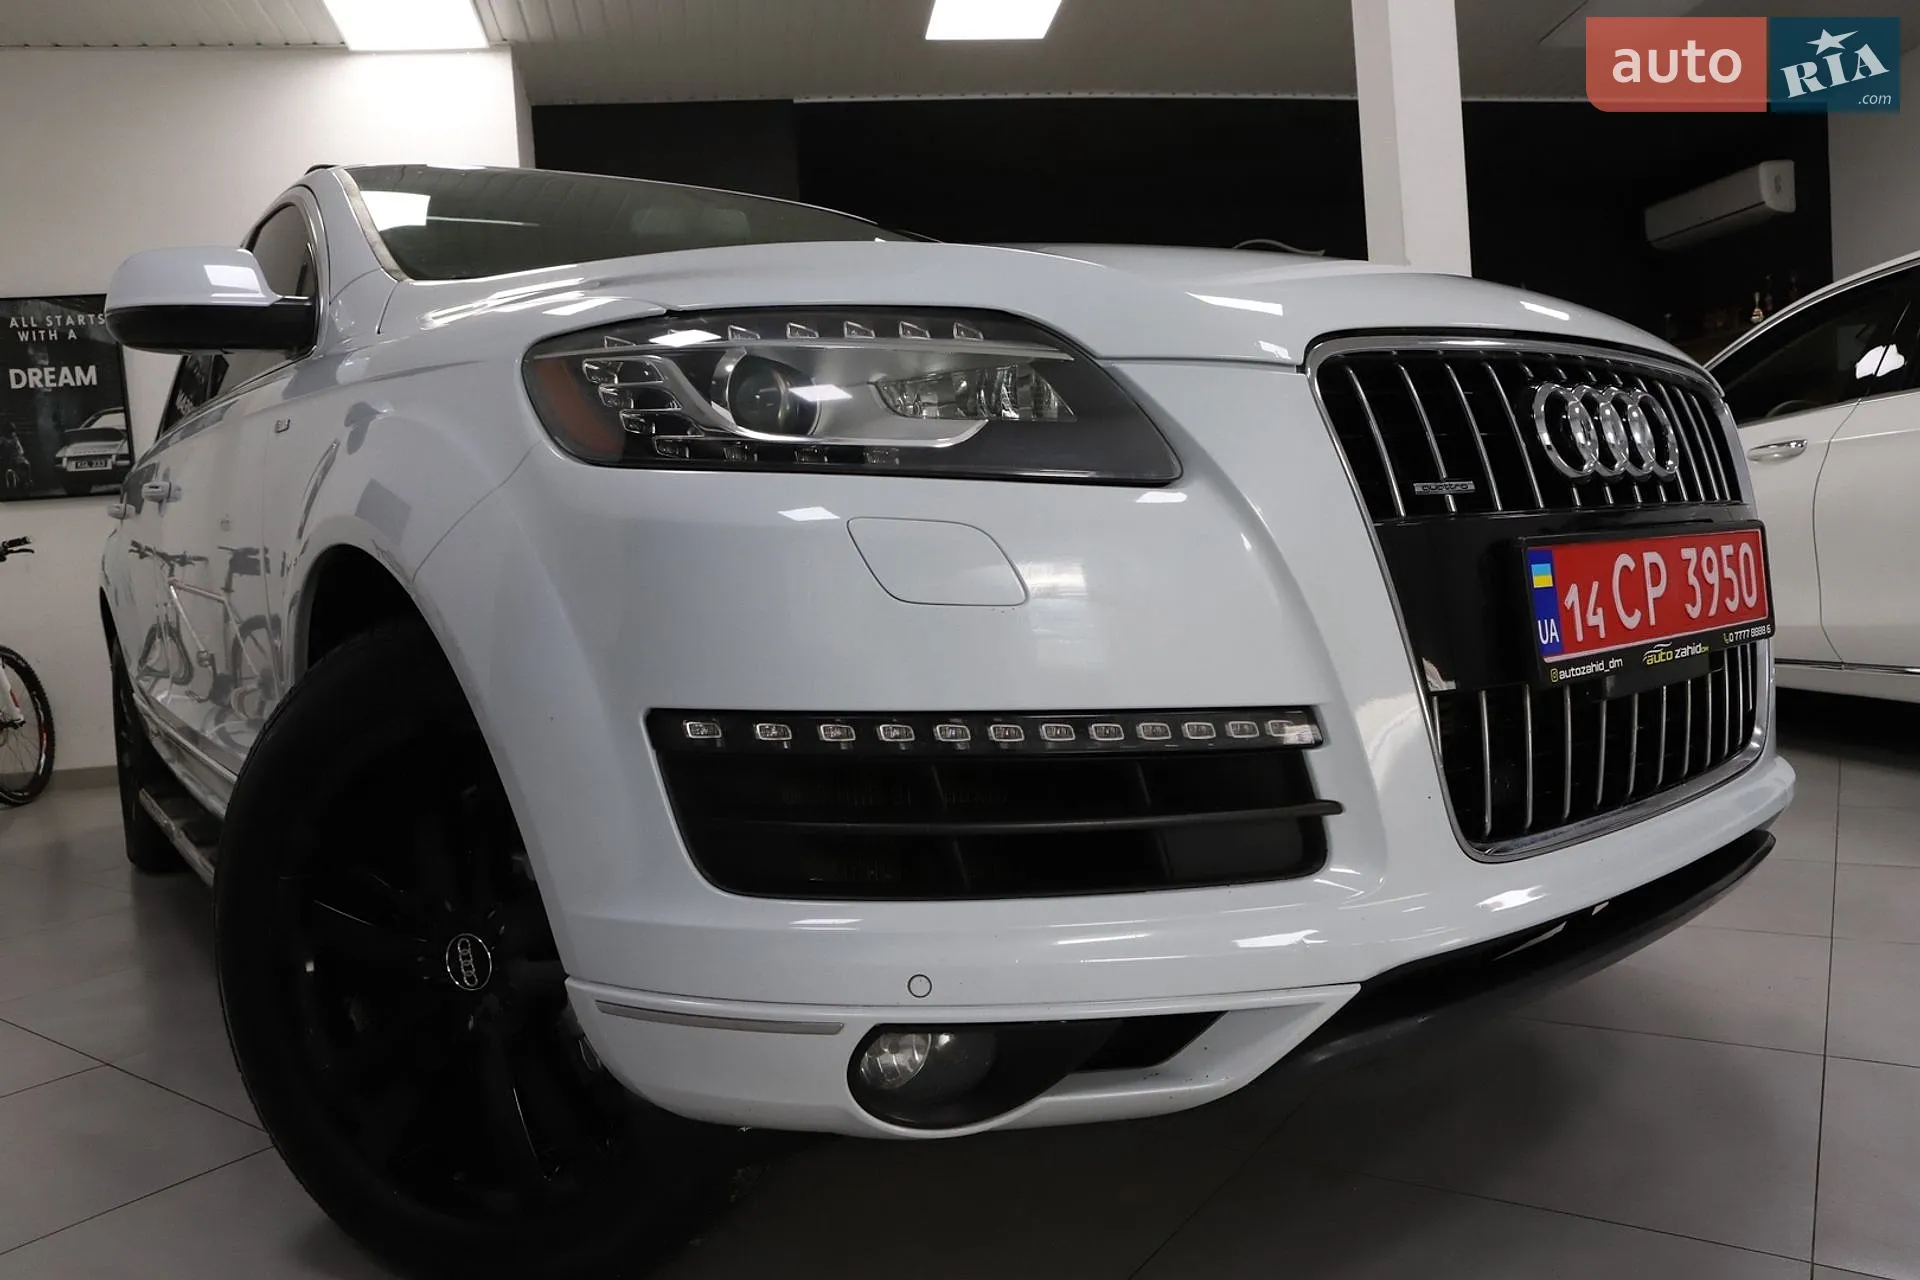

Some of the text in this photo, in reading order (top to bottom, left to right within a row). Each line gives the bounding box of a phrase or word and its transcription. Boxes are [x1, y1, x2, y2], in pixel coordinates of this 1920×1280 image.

[9, 313, 106, 329] ALL STARTS
[18, 329, 78, 342] WITH A
[9, 365, 98, 389] DREAM
[1564, 542, 1758, 642] 14 CP 3950
[1537, 618, 1560, 645] UA
[1646, 648, 1673, 665] auto
[1674, 642, 1702, 659] zahid
[1558, 657, 1623, 680] autozahid_dm
